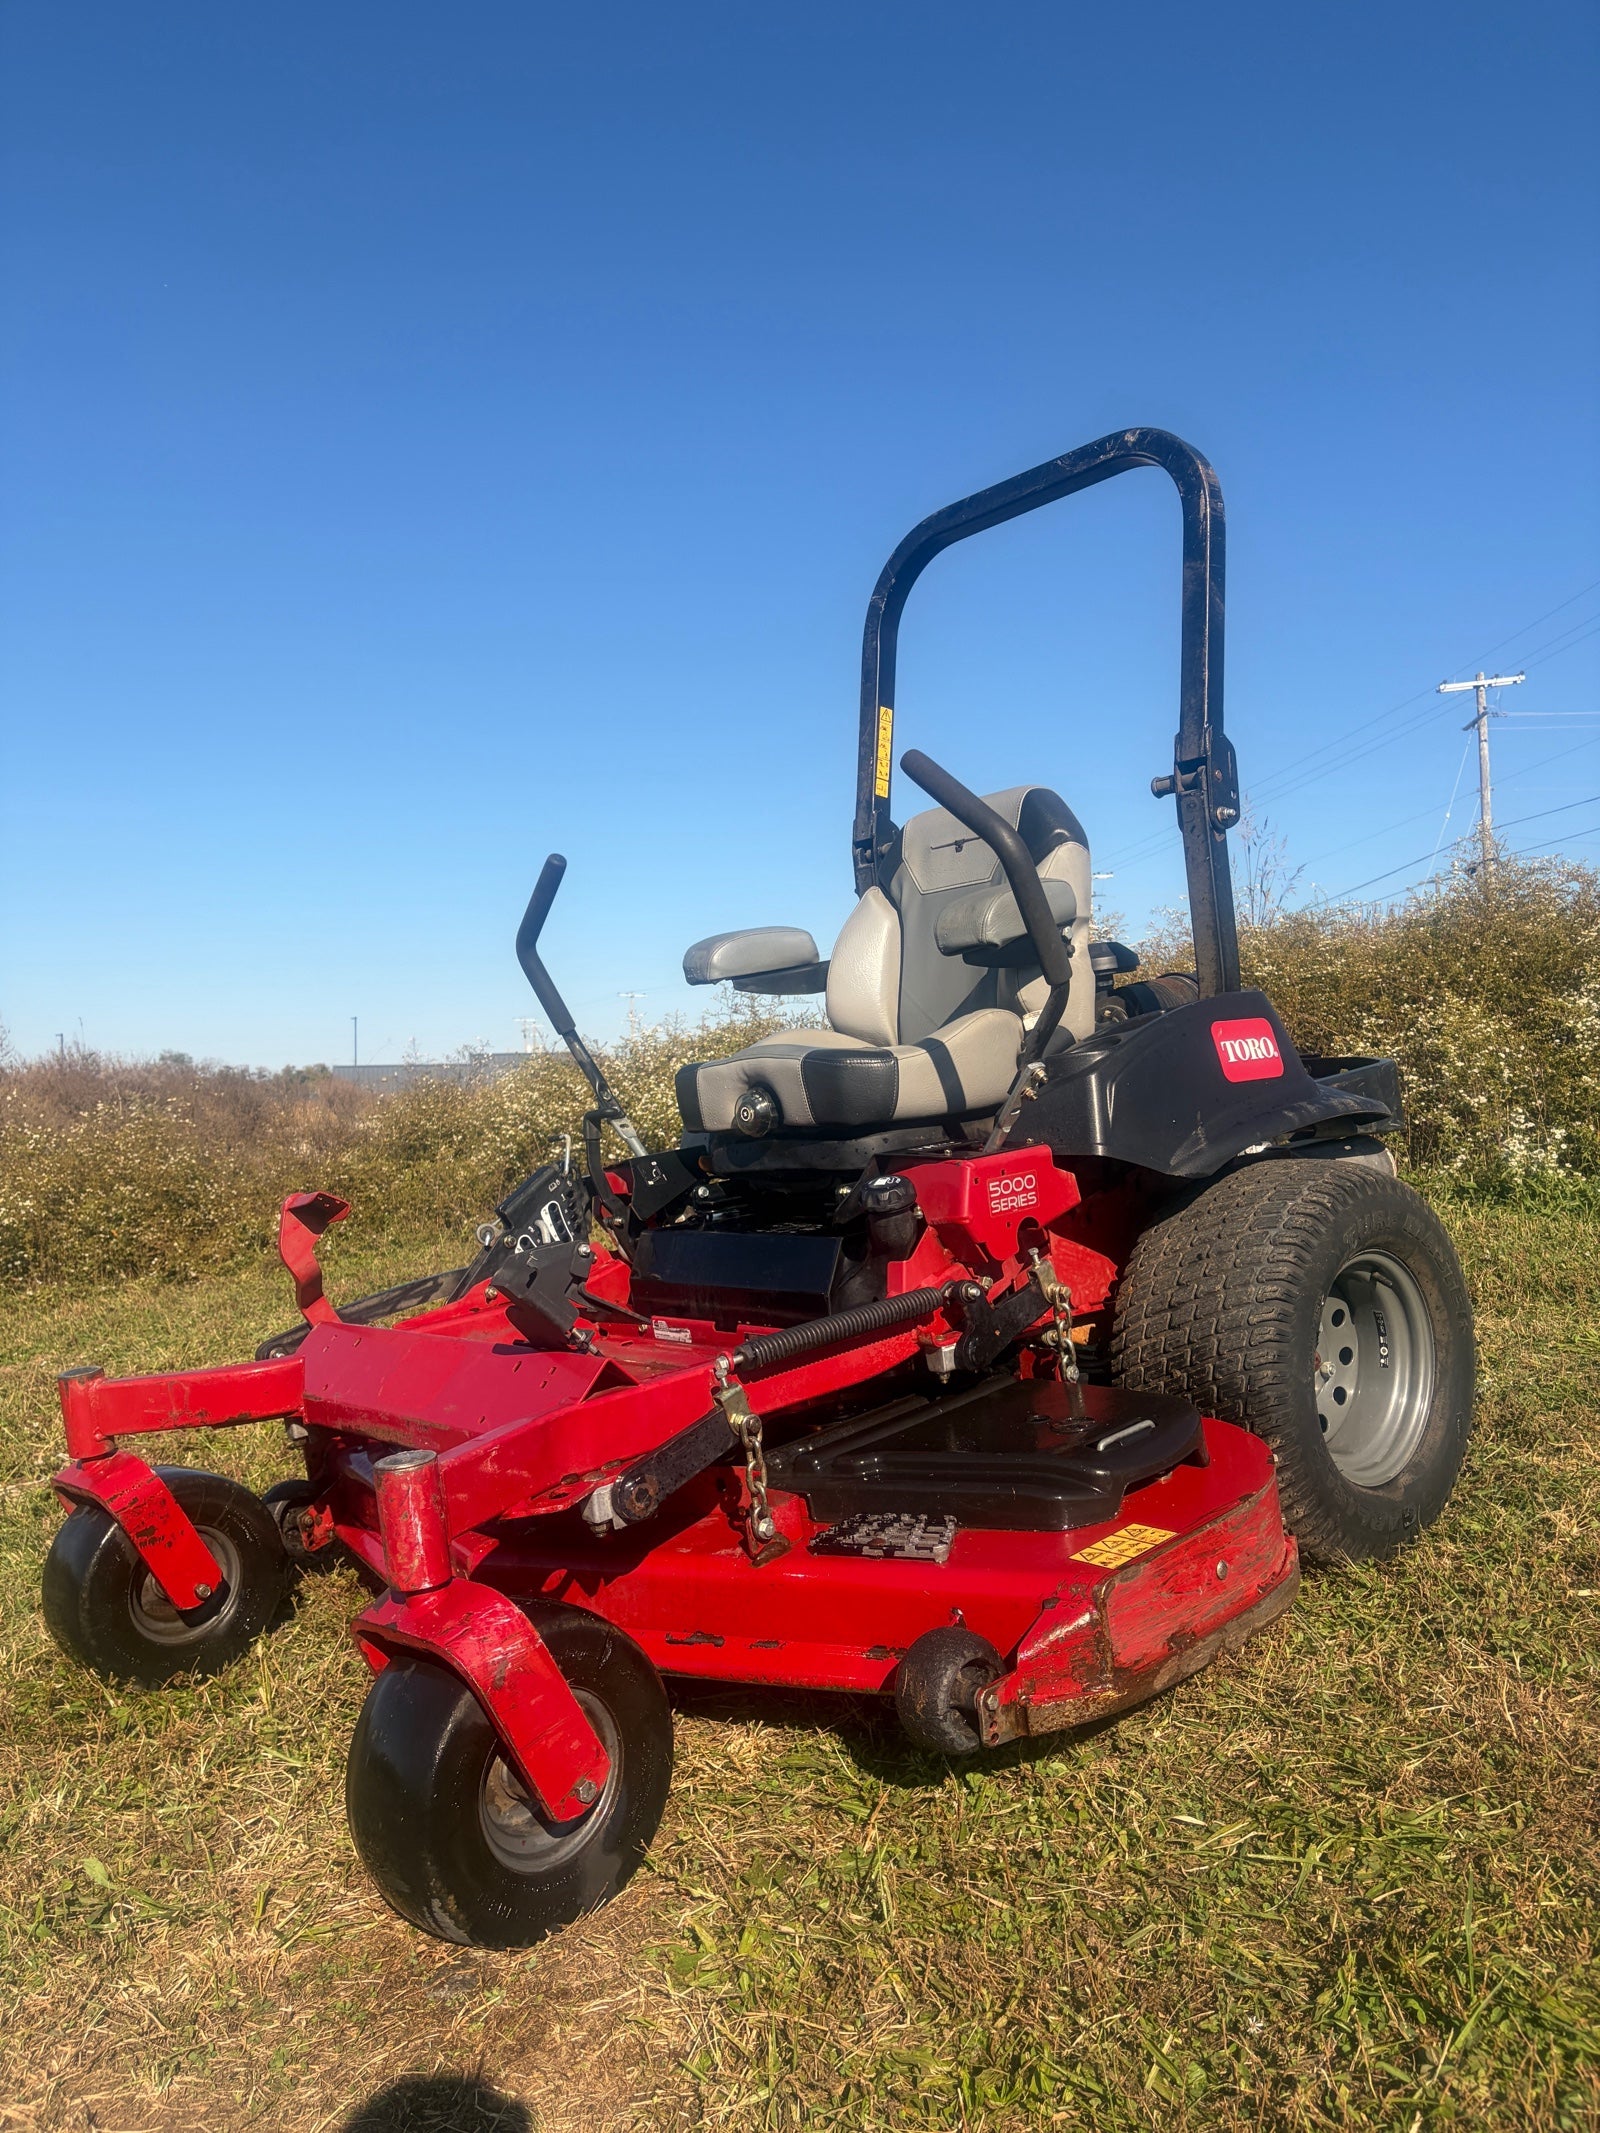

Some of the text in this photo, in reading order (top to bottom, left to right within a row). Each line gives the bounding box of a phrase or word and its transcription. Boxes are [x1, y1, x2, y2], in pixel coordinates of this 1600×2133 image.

[1220, 1036, 1274, 1063] TORO
[989, 1174, 1036, 1198] 5000
[990, 1191, 1037, 1214] SERIES
